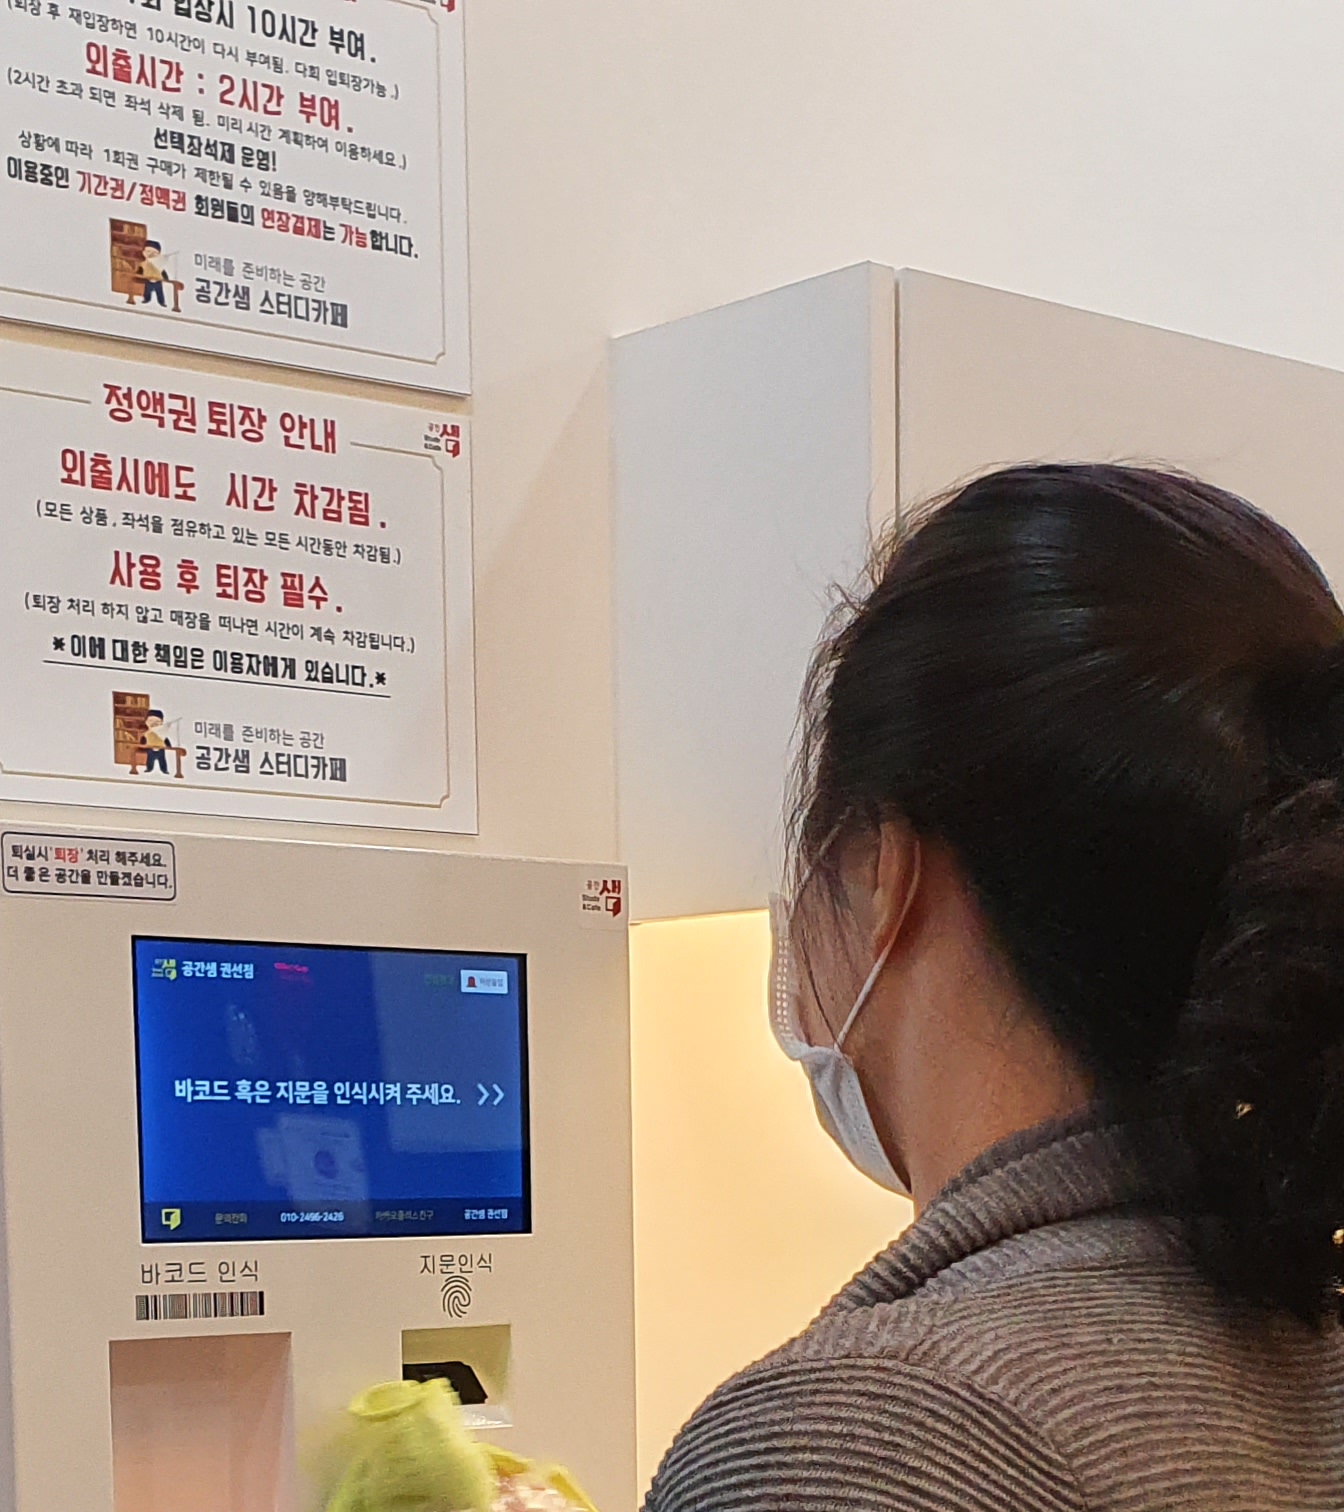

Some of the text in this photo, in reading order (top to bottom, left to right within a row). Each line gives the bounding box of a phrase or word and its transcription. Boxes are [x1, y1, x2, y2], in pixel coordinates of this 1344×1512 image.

[68, 7, 240, 62] 재입장하면 10시간이 다시
[248, 6, 376, 62] 10시간 부여.
[8, 66, 184, 122] (2시간 초과 되면 좌석 삭제
[85, 41, 353, 133] 외출시간 2시간 부여.
[18, 130, 60, 153] 상황에
[65, 141, 93, 160] 따라
[103, 148, 139, 171] 1회권
[146, 156, 186, 179] 구매가
[259, 180, 297, 204] 있음을
[154, 127, 235, 164] 선택좌석제
[7, 156, 335, 241] 이용중인 기간권/정액권 회원들의 연장결제는
[194, 253, 326, 293] 미래를 준비하는 공간
[259, 290, 348, 329] 스터디카페
[103, 383, 337, 454] 정액권 퇴장 안내
[61, 448, 387, 529] 외출시에도 시간 차감됨.
[36, 499, 347, 559] (모든 좌석을 점유하고 있는 모든 시간동안
[109, 550, 343, 613] 사용 후 퇴장 필수.
[24, 592, 336, 646] (퇴장 처리 하지 않고 매장을 떠나면 시간이 계속
[112, 638, 296, 681] 대한 책임은 이용자에게
[194, 721, 325, 750] 미래를 준비하는 공간
[260, 752, 347, 782] 스터디카페
[7, 866, 18, 882] 더
[174, 1078, 461, 1106] 바코드 혹은 지문을 인식시켜 주세요.
[141, 1260, 260, 1286] 바코드 인식
[419, 1256, 492, 1281] 지문인식
